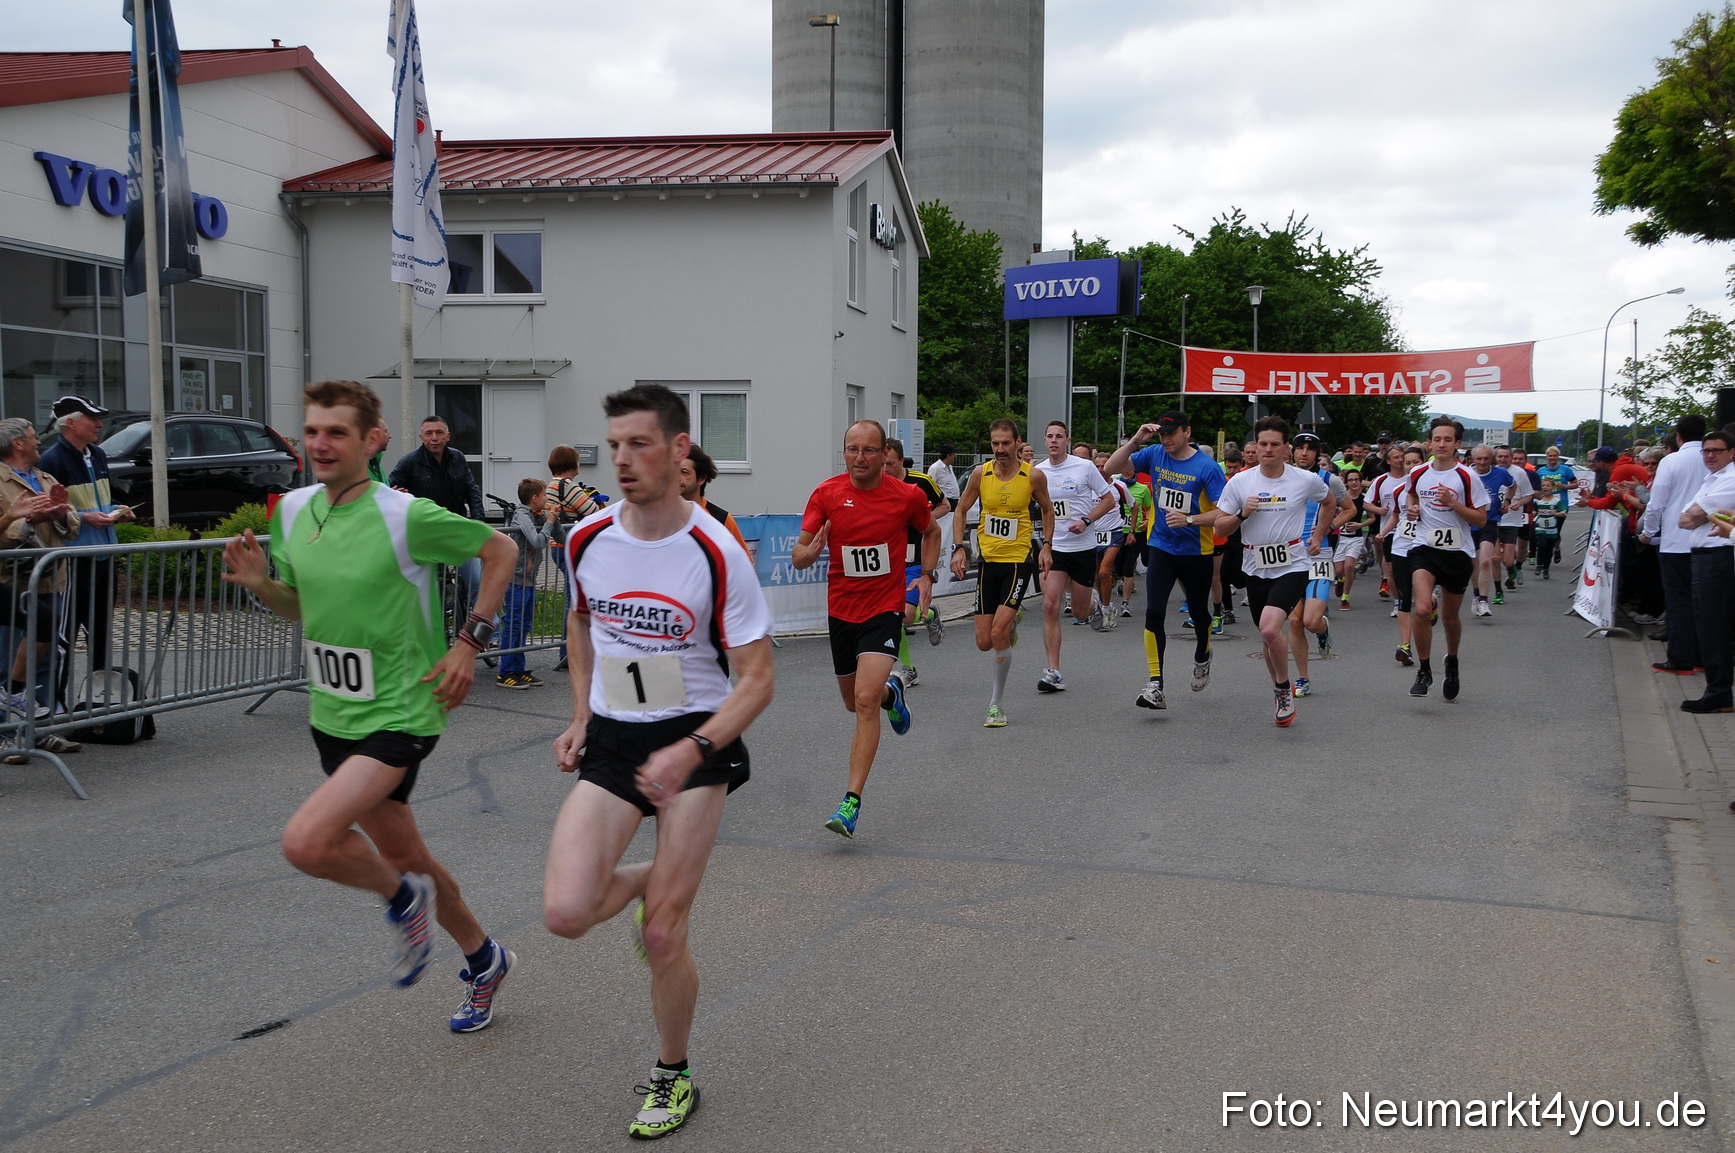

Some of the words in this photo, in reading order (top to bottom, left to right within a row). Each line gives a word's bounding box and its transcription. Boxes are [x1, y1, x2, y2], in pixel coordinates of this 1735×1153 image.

[34, 151, 229, 240] VOO
[1013, 276, 1101, 301] VOLVO
[1053, 500, 1066, 517] 31
[1166, 490, 1185, 510] 119
[990, 517, 1011, 537] 118
[1095, 532, 1108, 544] 04
[1434, 529, 1454, 547] 24
[770, 536, 776, 552] 1
[1258, 544, 1288, 566] 106
[851, 547, 881, 573] 113
[1312, 562, 1330, 578] 141
[770, 562, 782, 584] 4
[784, 560, 830, 583] VORT
[589, 598, 672, 622] GERHART
[313, 646, 362, 692] 100
[626, 661, 647, 704] 1
